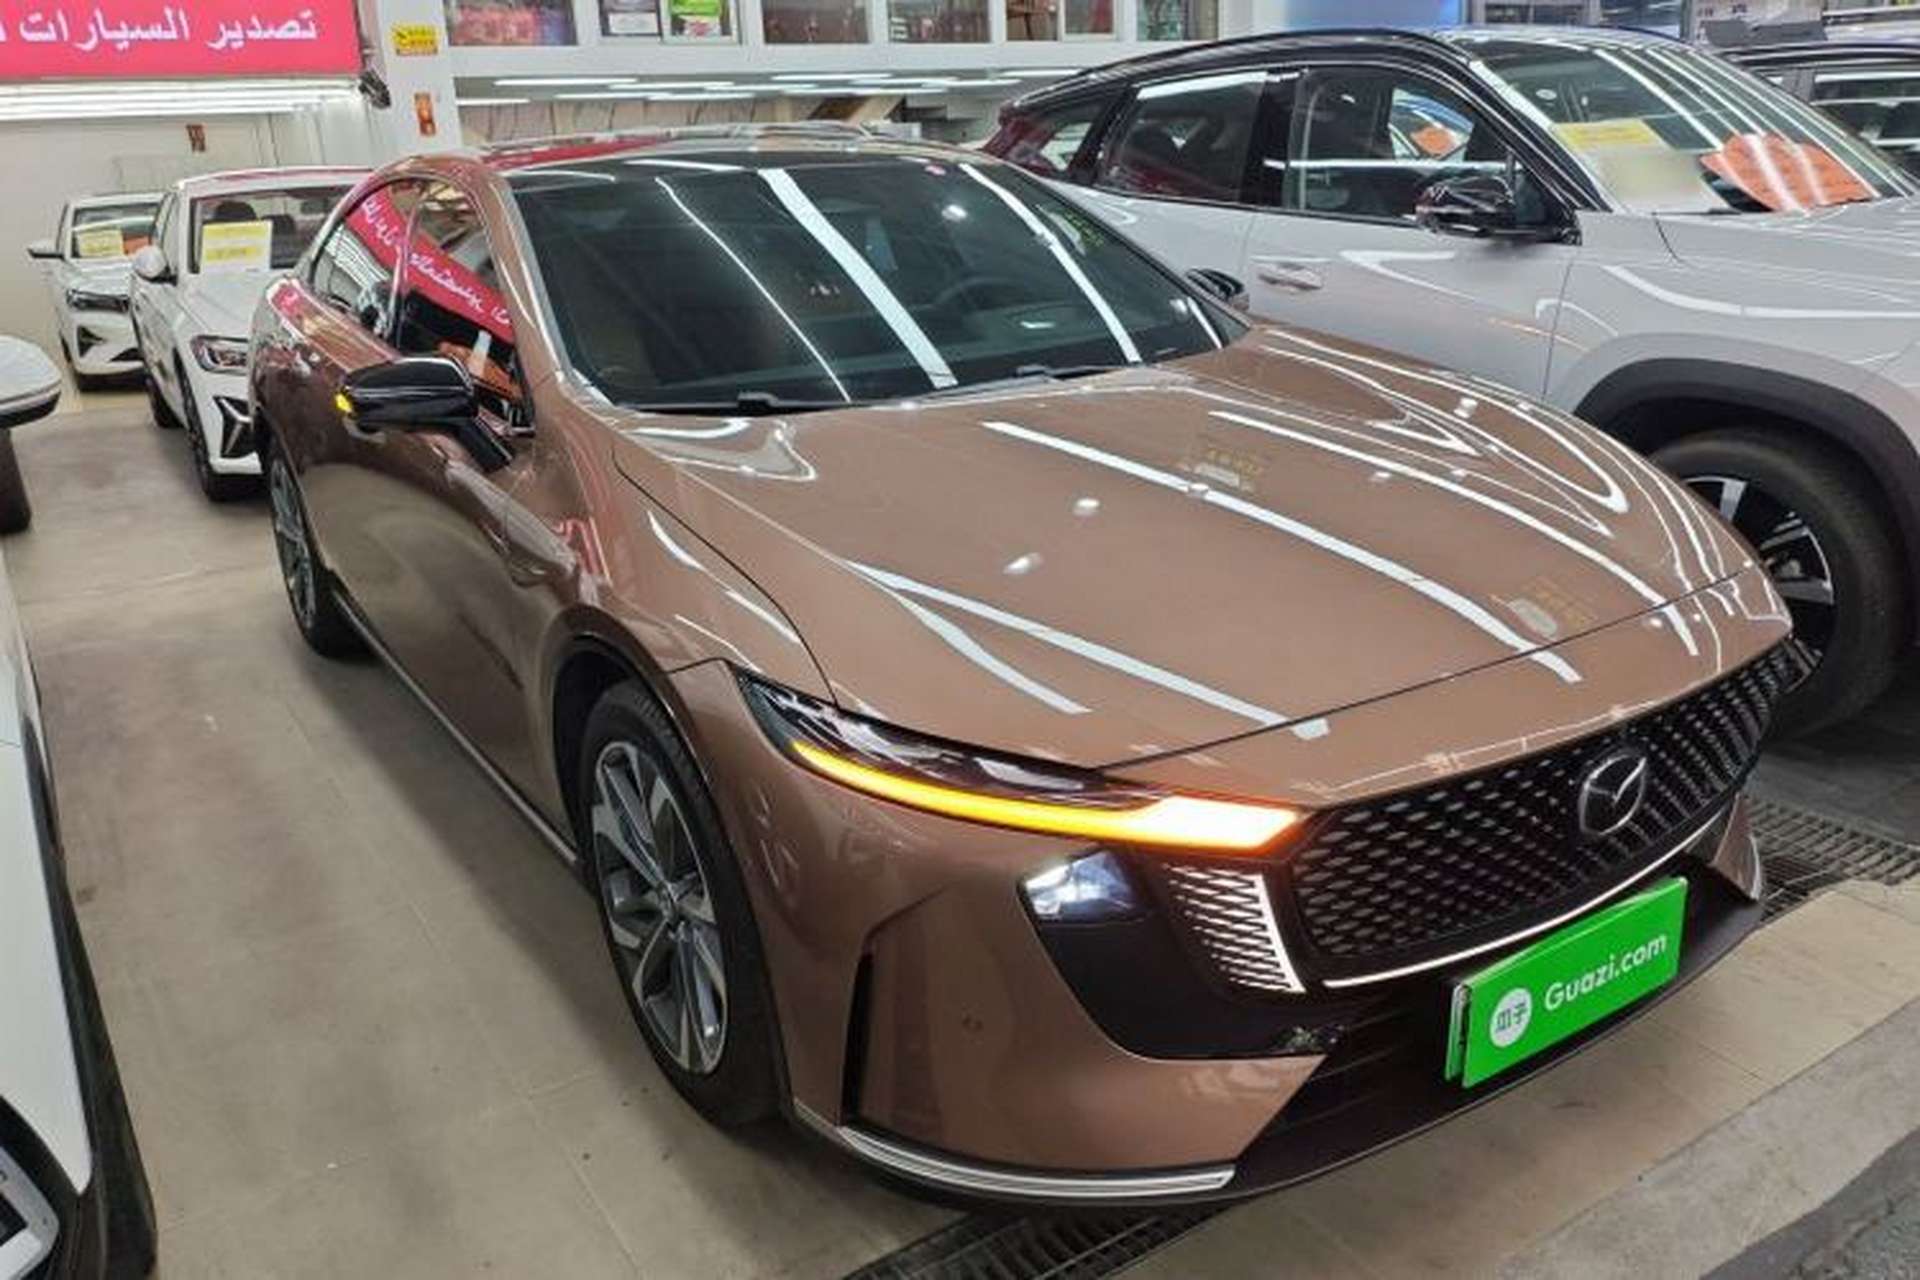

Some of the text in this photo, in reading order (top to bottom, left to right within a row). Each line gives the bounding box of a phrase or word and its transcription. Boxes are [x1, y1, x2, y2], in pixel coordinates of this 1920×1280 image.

[19, 7, 190, 51] السيارات
[206, 9, 318, 50] تصدير
[1545, 934, 1667, 1011] Guazi.com
